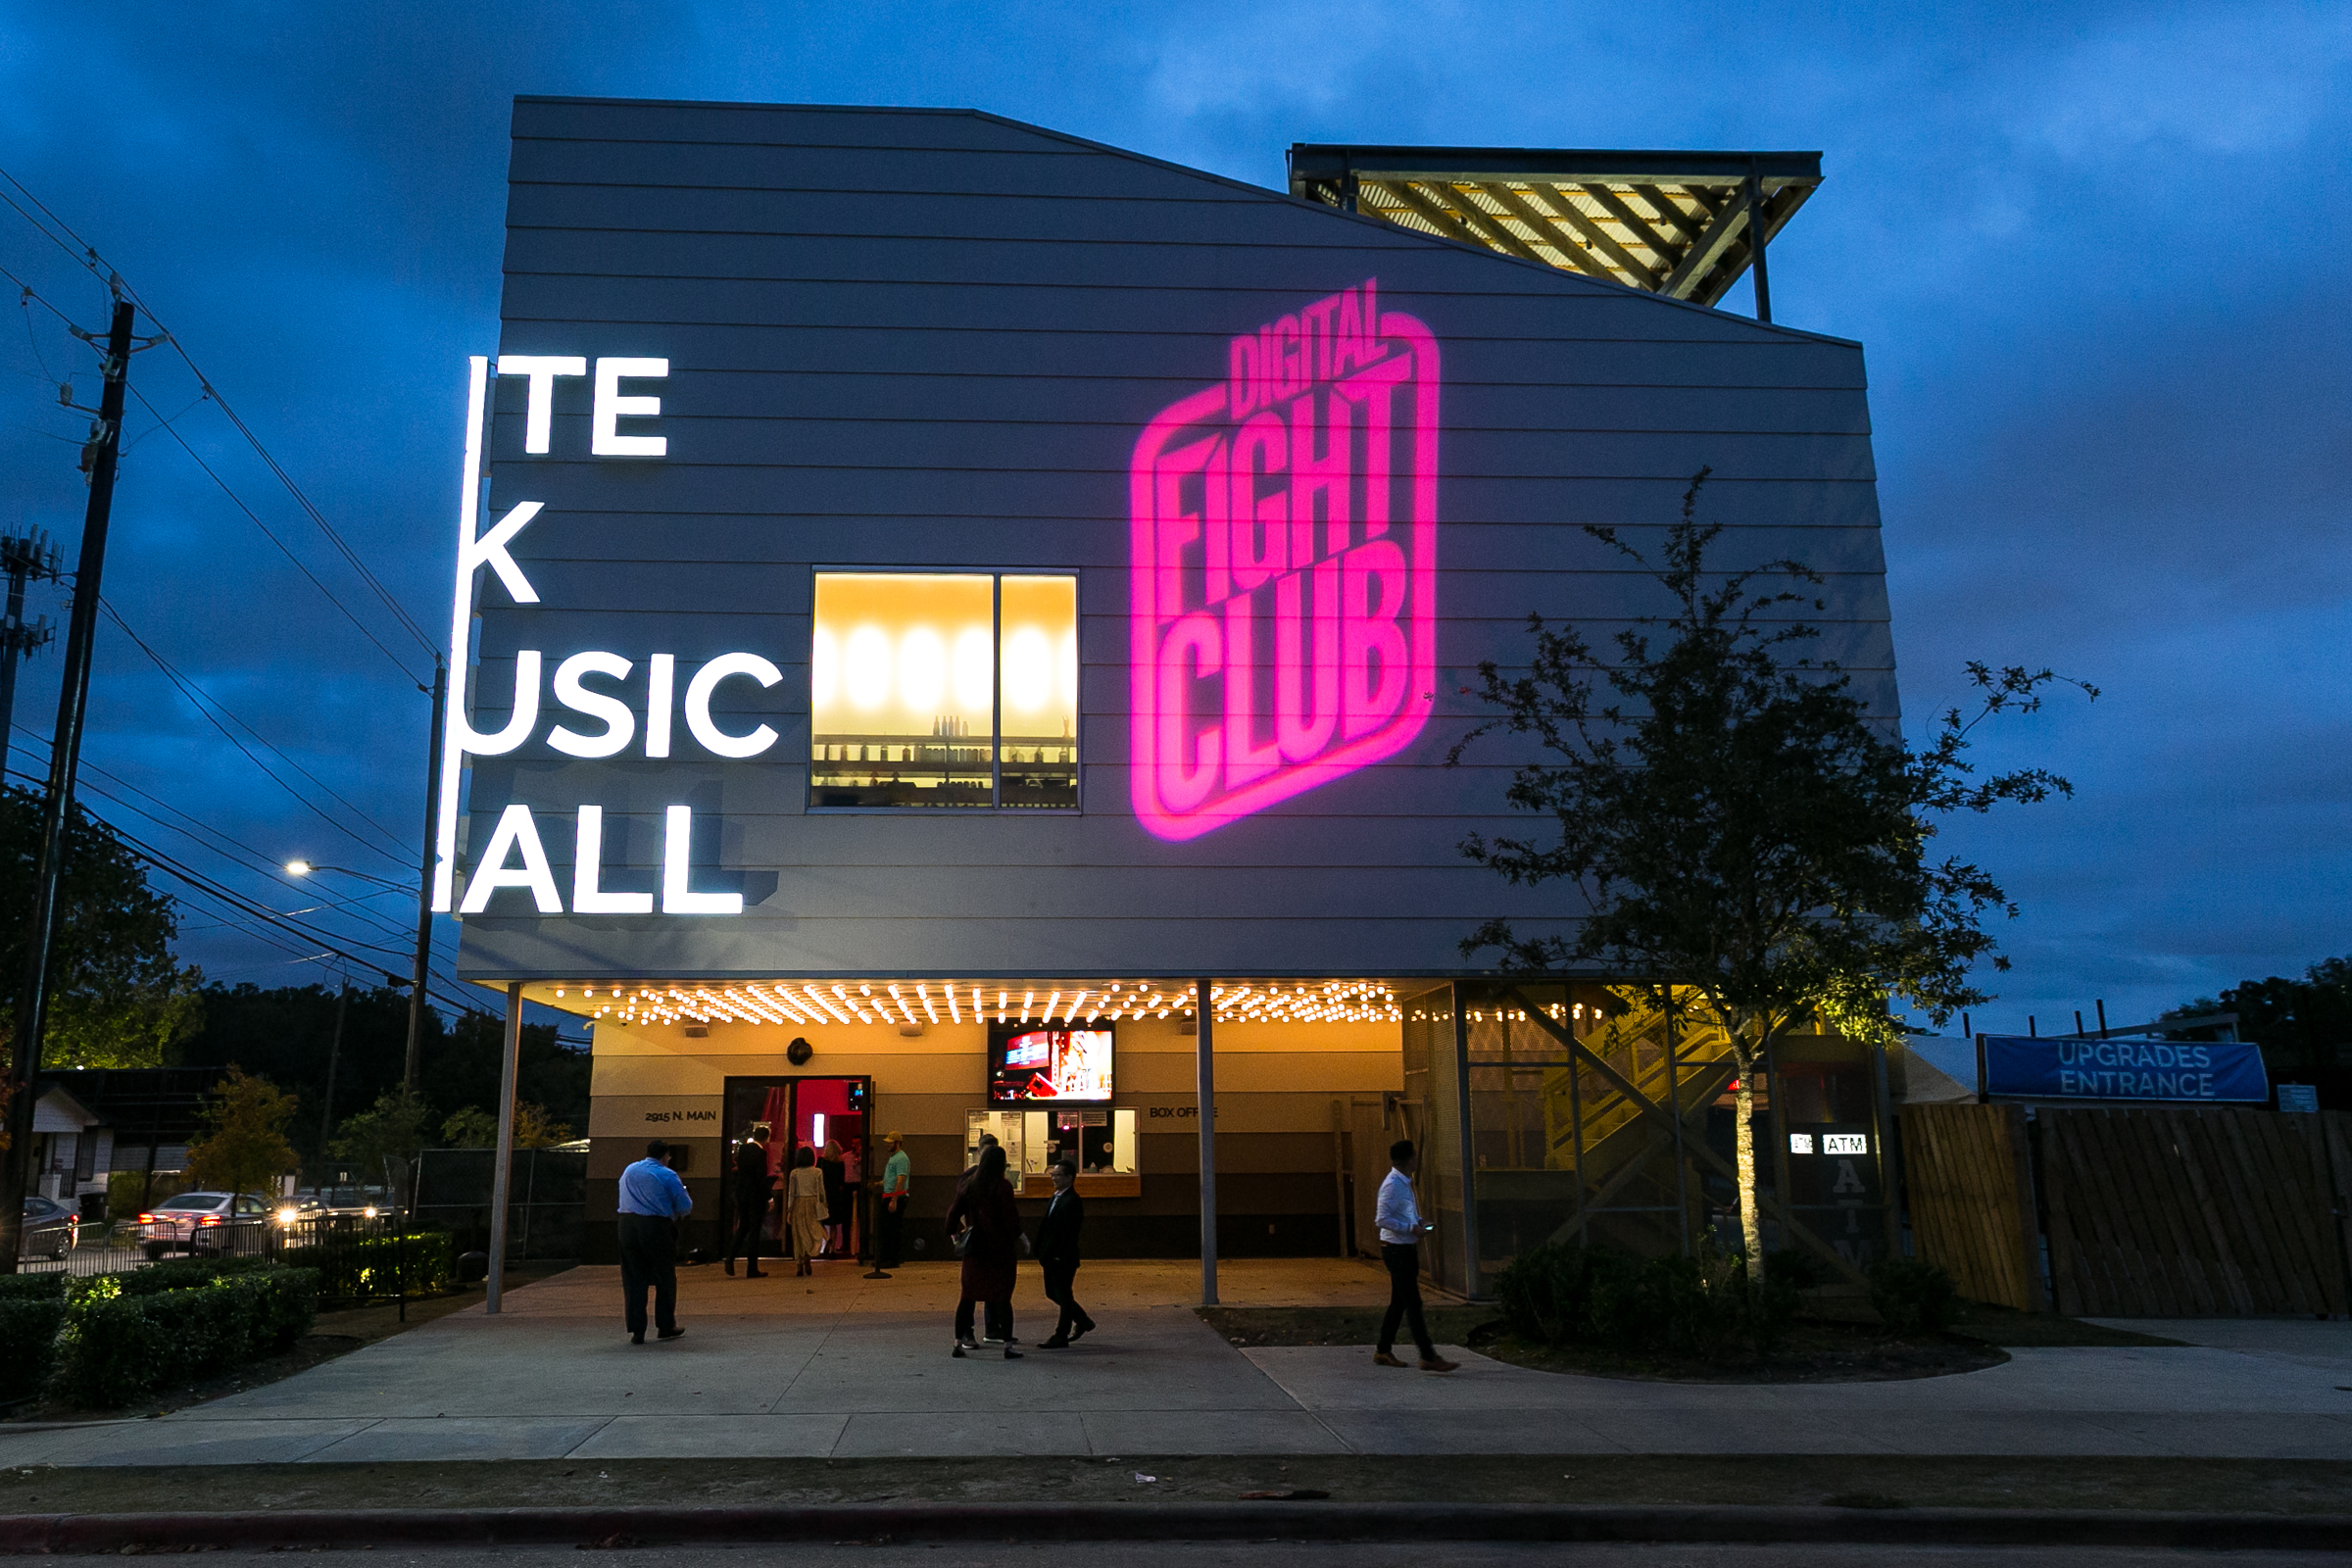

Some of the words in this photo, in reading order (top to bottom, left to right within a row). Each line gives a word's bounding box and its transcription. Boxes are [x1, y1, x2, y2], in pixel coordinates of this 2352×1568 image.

[1231, 276, 1388, 422] DIGITAL
[1156, 352, 1411, 626] FIGHT
[1156, 539, 1408, 812] CLUB
[2058, 1043, 2211, 1068] UPGRADES
[2060, 1069, 2216, 1097] ENTRANCE
[645, 1112, 670, 1123] 2915
[672, 1110, 684, 1121] N.
[686, 1110, 716, 1121] MAIN
[1150, 1107, 1175, 1118] BOX
[1177, 1107, 1219, 1118] OFFE
[1828, 1137, 1863, 1152] ATM
